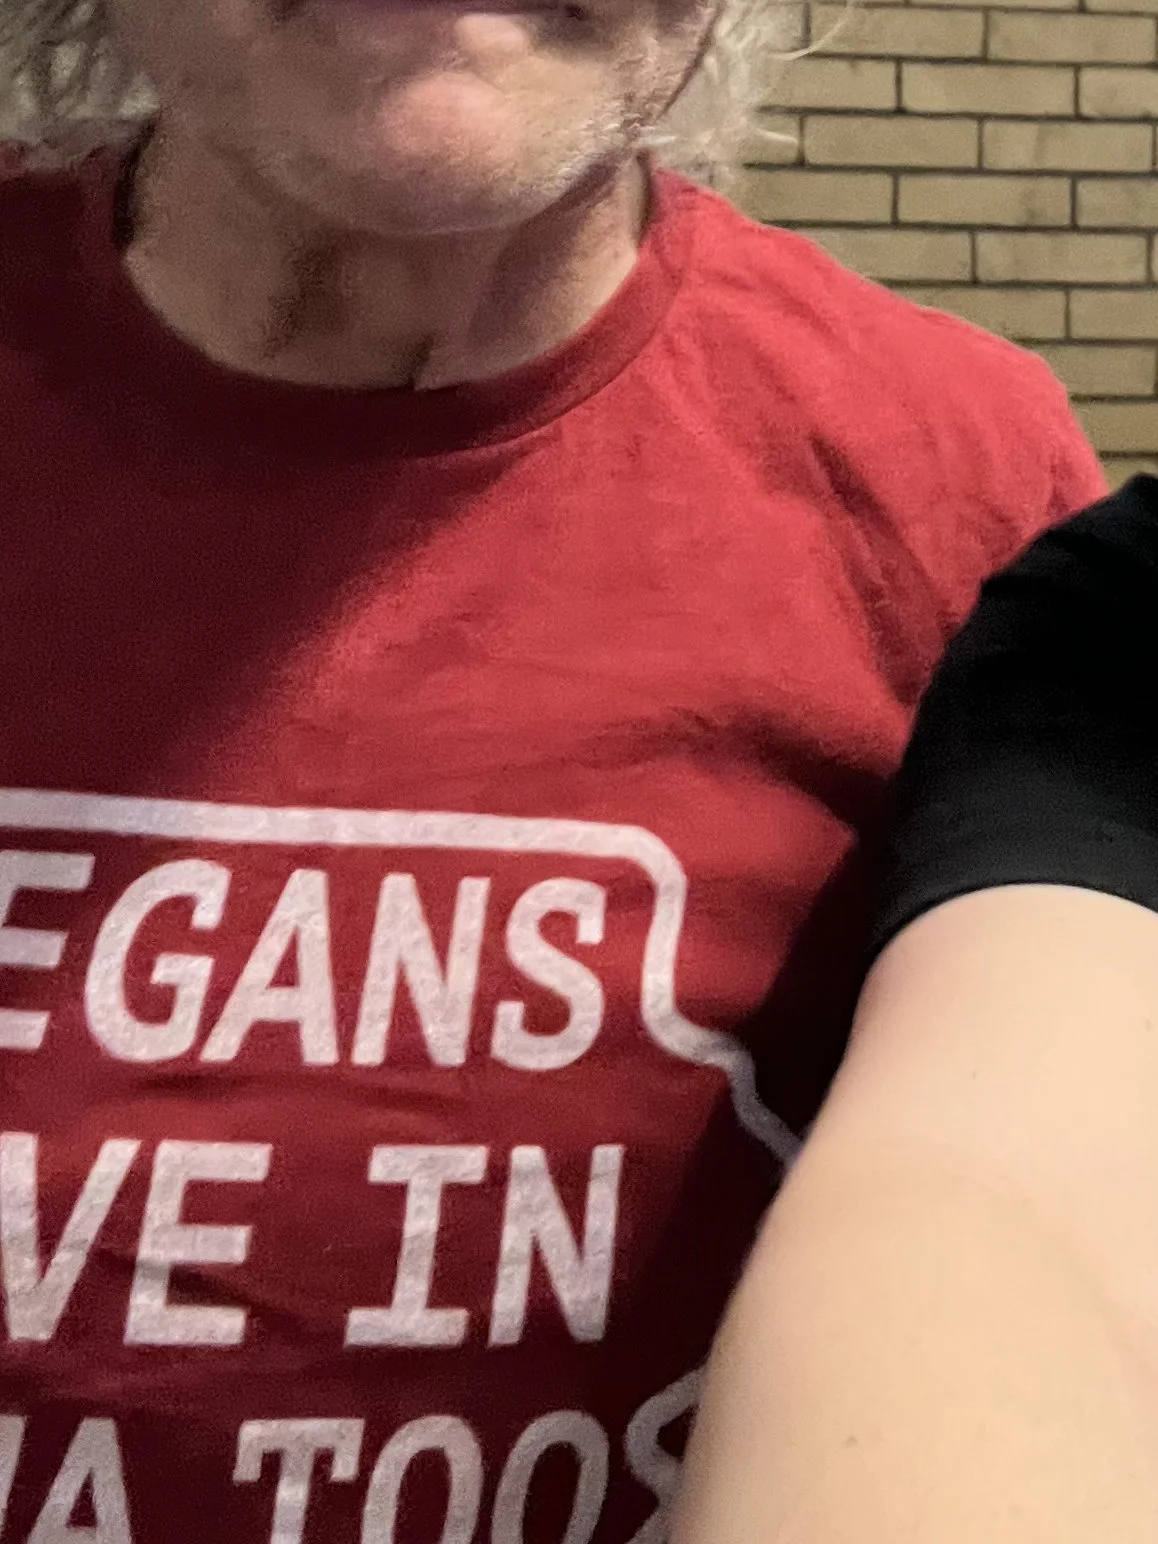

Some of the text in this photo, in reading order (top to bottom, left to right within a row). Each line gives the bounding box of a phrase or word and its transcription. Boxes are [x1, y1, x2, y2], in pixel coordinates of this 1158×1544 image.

[0, 1131, 625, 1348] VE IN
[0, 1409, 610, 1544] A TOO
